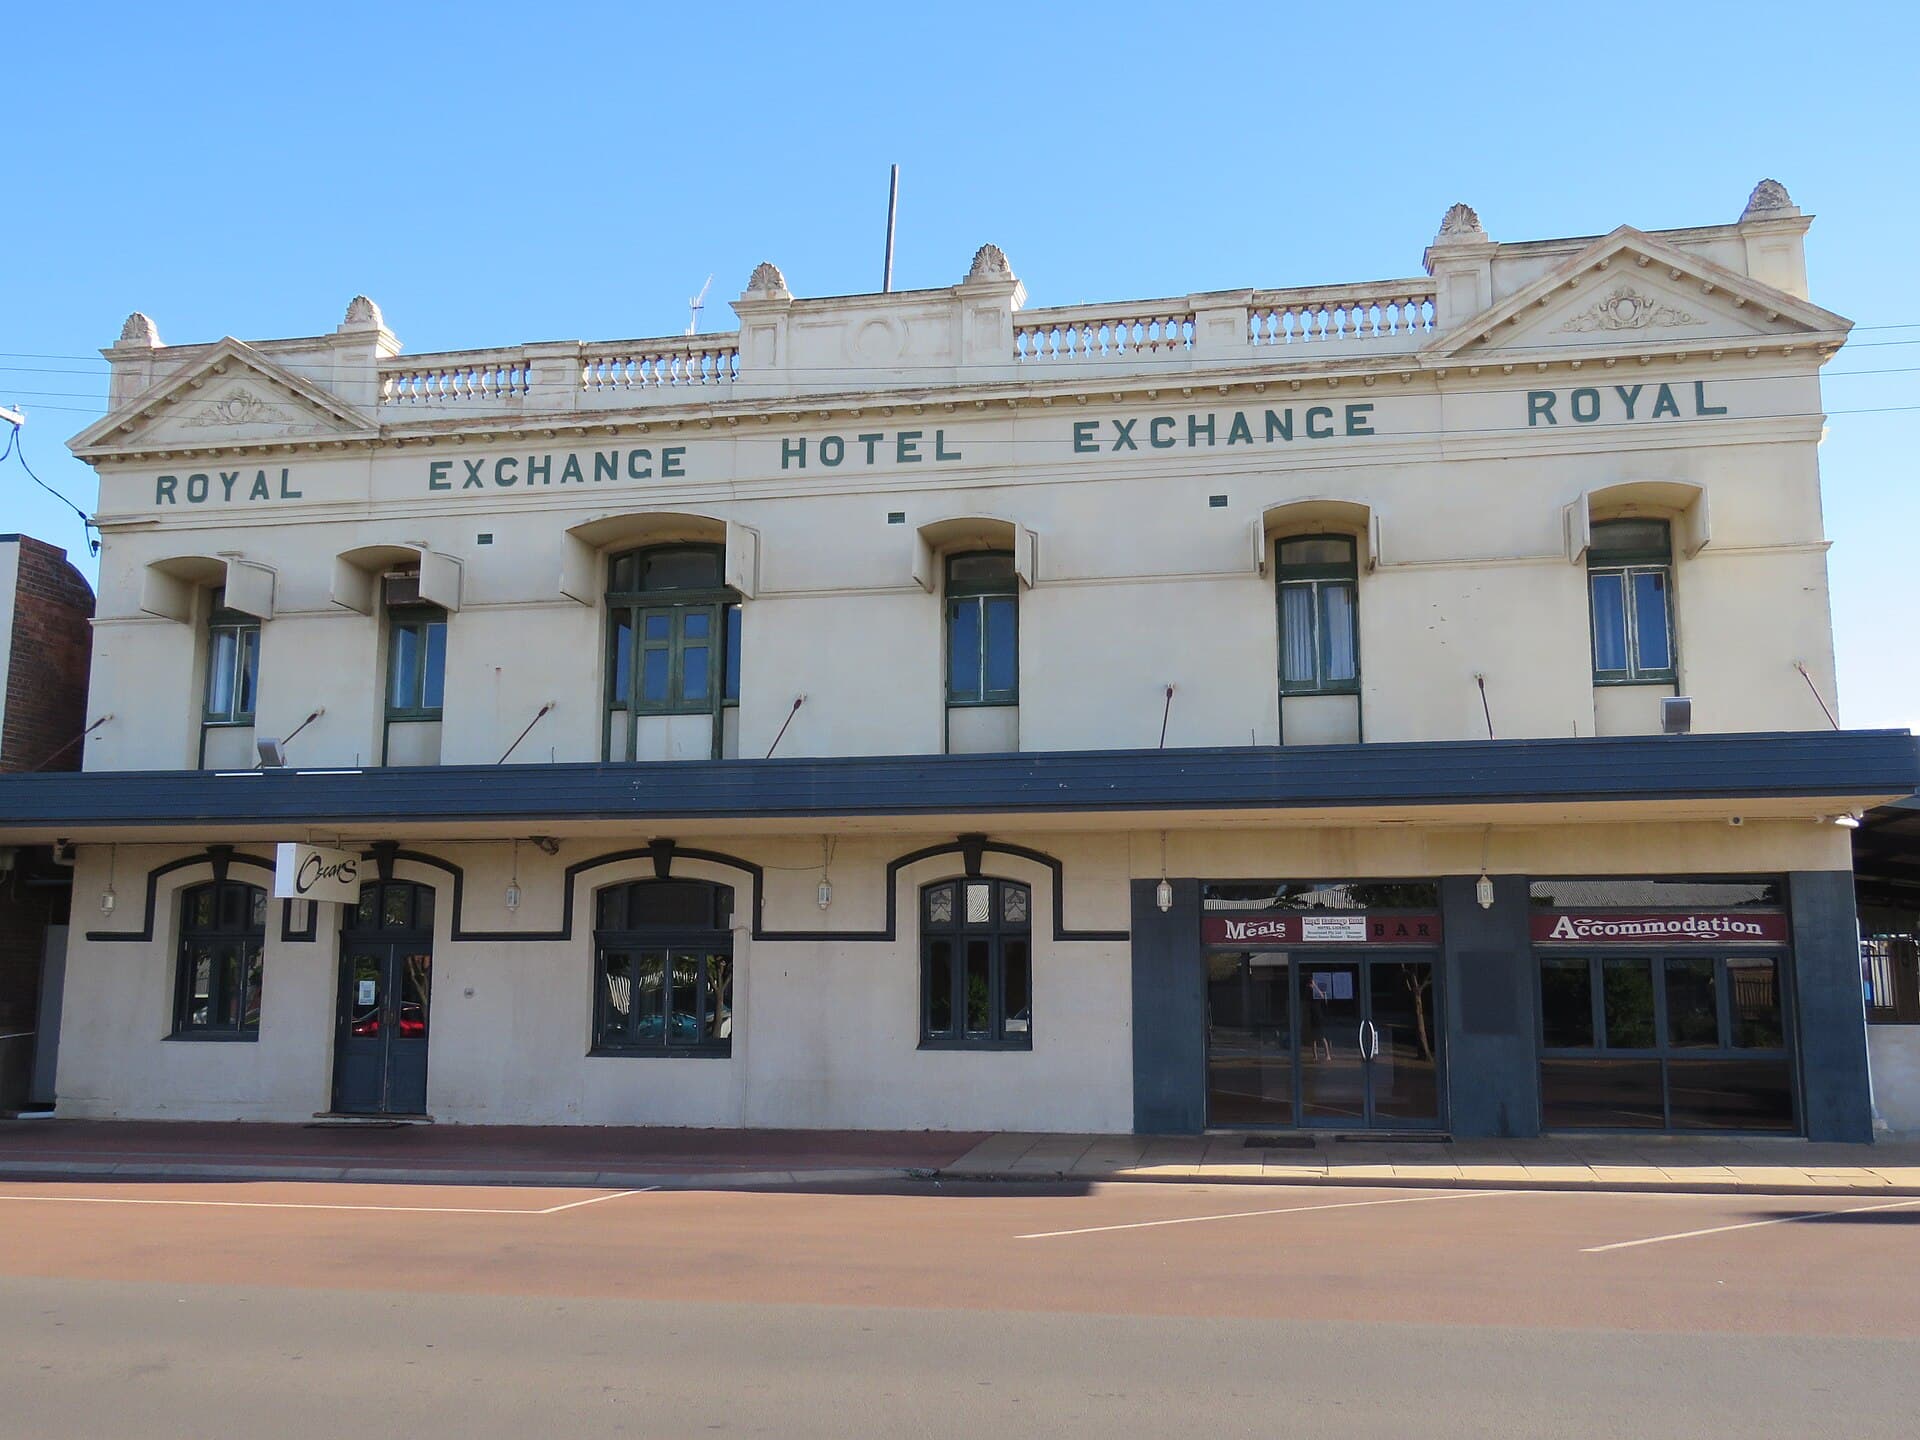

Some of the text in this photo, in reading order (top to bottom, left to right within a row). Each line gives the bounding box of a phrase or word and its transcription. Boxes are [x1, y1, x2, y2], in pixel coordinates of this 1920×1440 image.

[155, 380, 1727, 504] ROYAL EXCHANGE HOTEL EXCHANGE ROYAL
[1224, 919, 1286, 940] Meals
[1374, 923, 1431, 936] BAR
[1549, 915, 1763, 940] Accommodation
